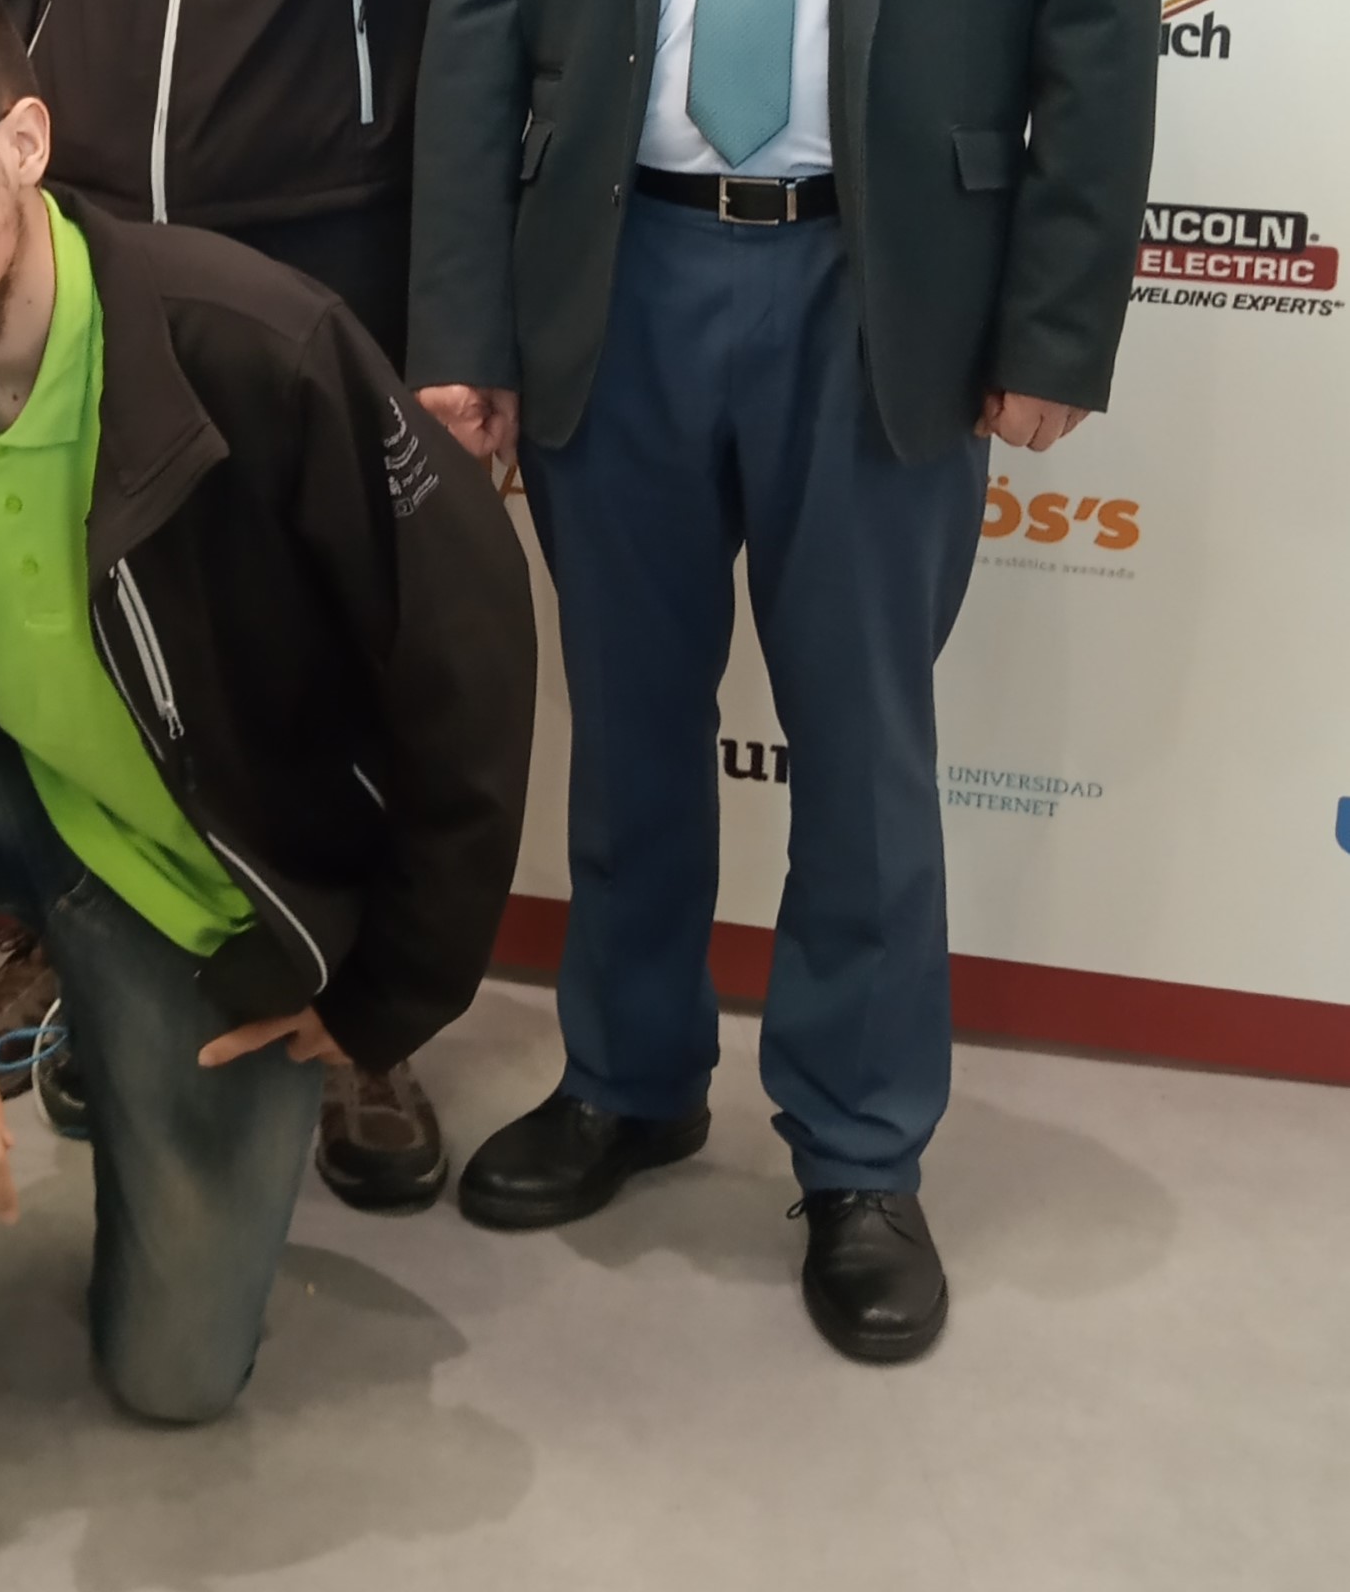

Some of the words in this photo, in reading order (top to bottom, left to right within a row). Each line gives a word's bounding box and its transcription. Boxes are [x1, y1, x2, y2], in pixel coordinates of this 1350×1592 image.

[1140, 248, 1316, 284] ELECTRIC
[1129, 285, 1228, 309] WELDING
[948, 766, 1103, 799] UNIVERSIDAD
[947, 790, 1059, 818] INTERNET
